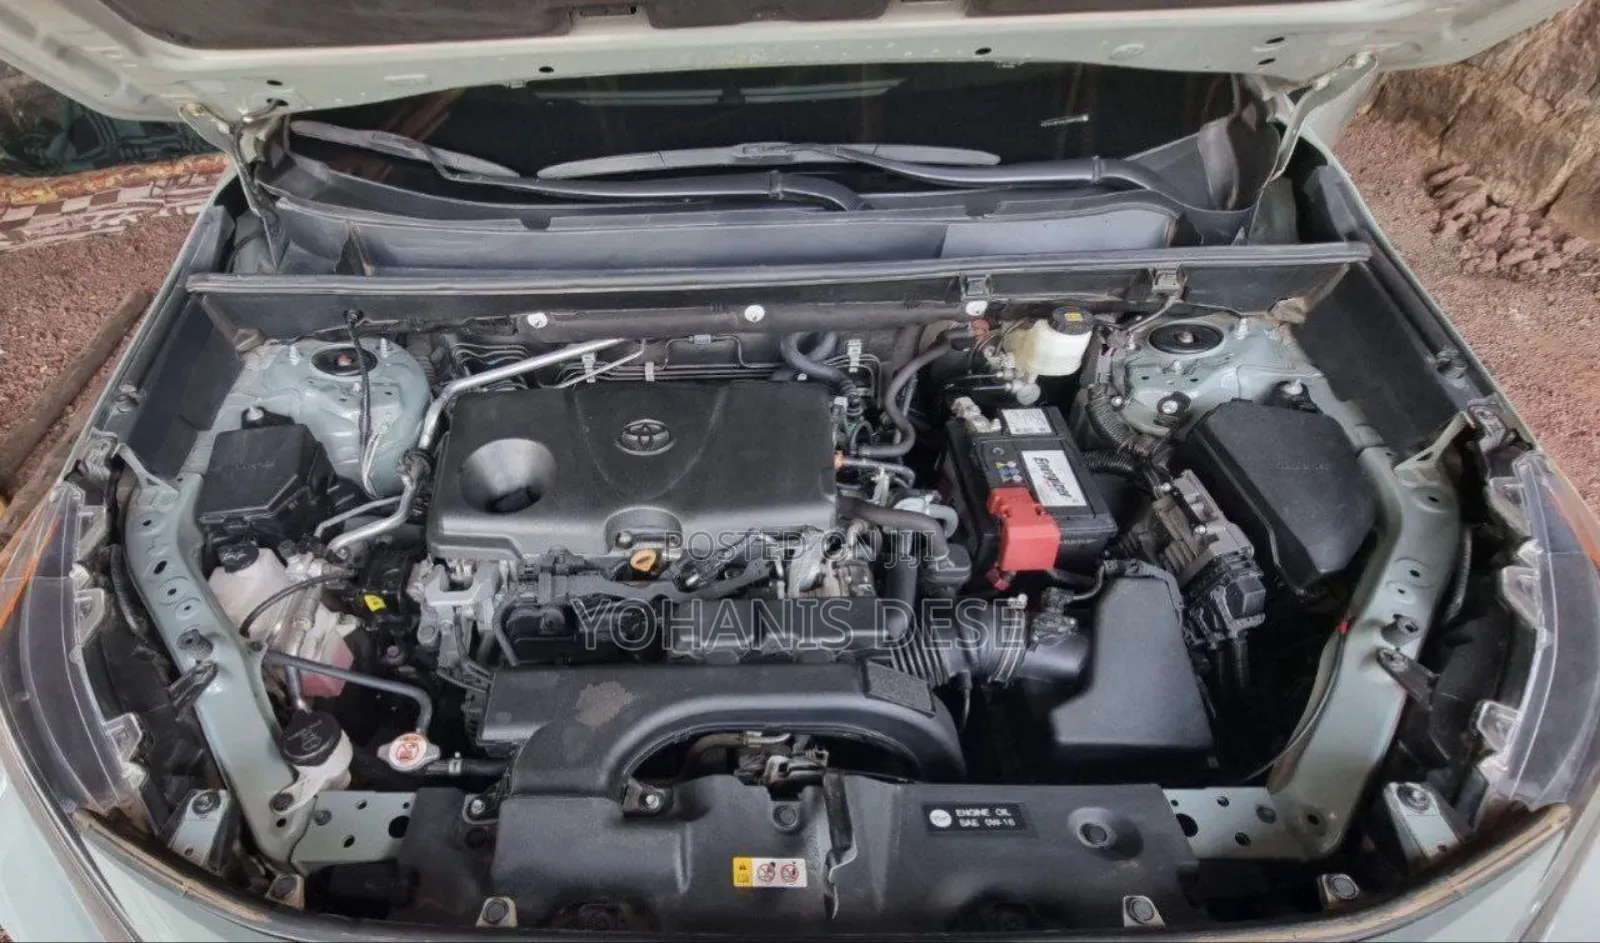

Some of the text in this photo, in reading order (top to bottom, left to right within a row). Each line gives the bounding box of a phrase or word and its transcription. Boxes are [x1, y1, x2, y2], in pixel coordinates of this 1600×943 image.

[955, 808, 1012, 817] ENGINE OIL
[959, 818, 980, 827] SAE
